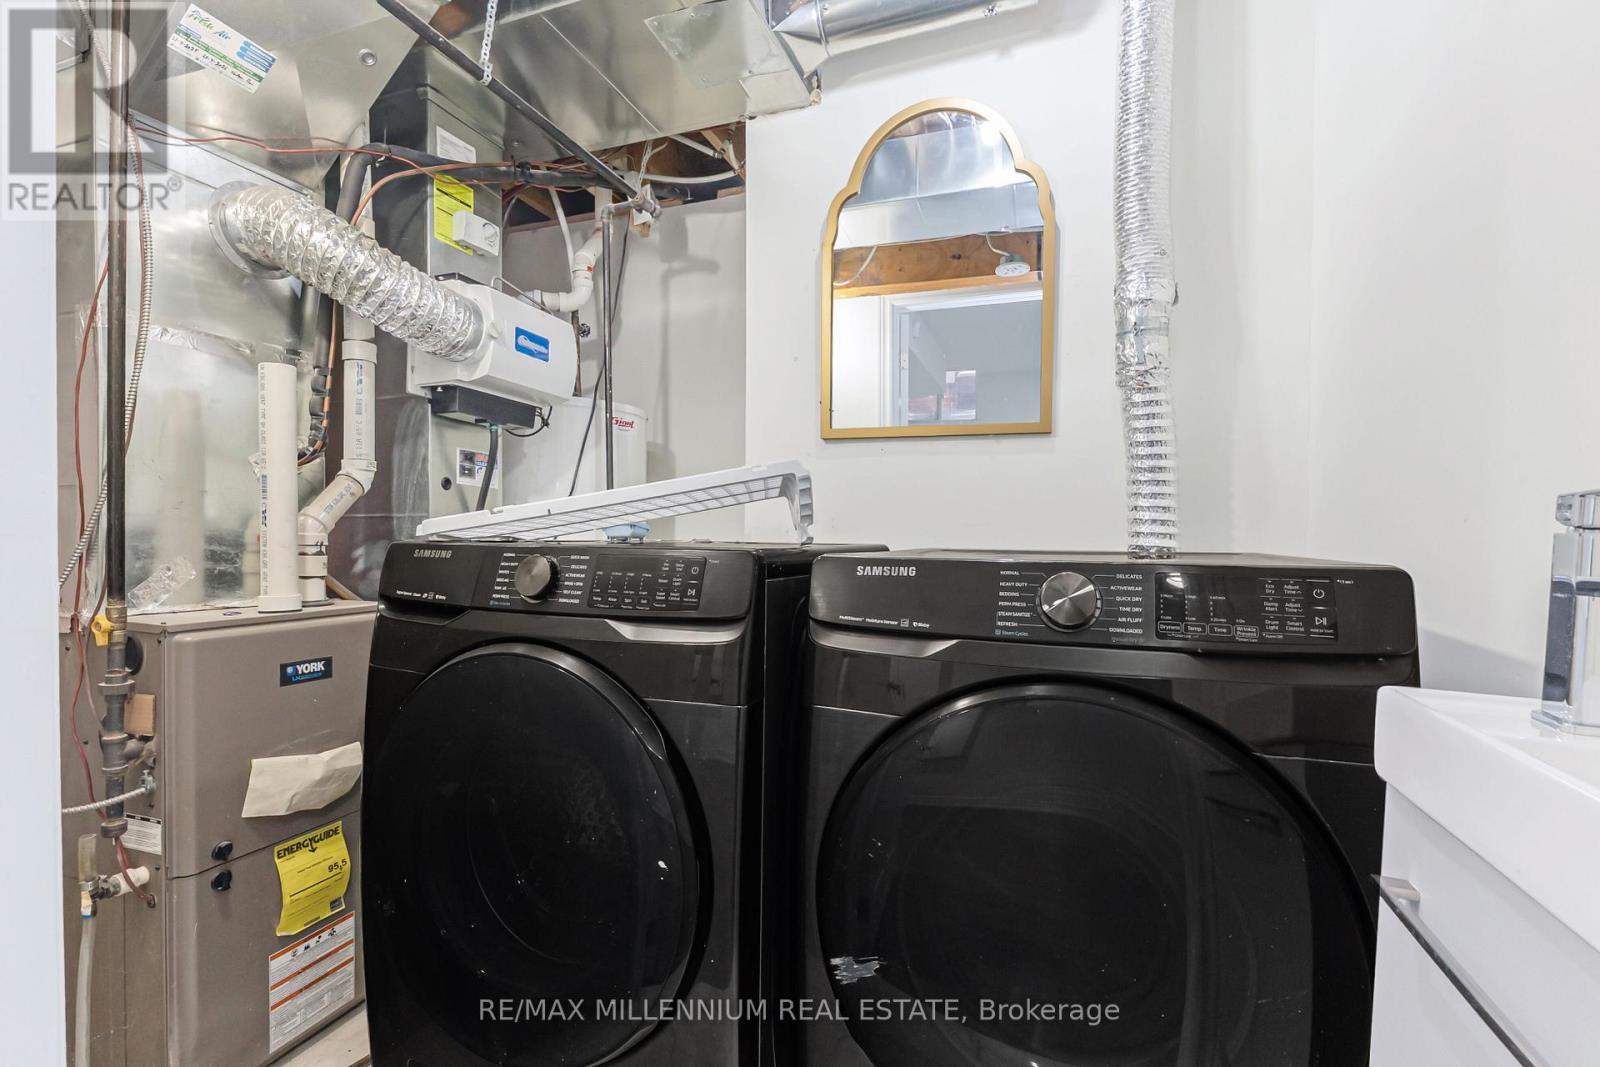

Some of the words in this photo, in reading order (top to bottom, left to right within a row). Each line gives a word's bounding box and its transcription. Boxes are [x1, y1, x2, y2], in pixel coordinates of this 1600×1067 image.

[414, 549, 452, 559] SAMSUNG
[856, 565, 917, 577] SAMSUNG
[296, 661, 327, 674] YORK
[277, 826, 340, 859] ENERGYGUIDE
